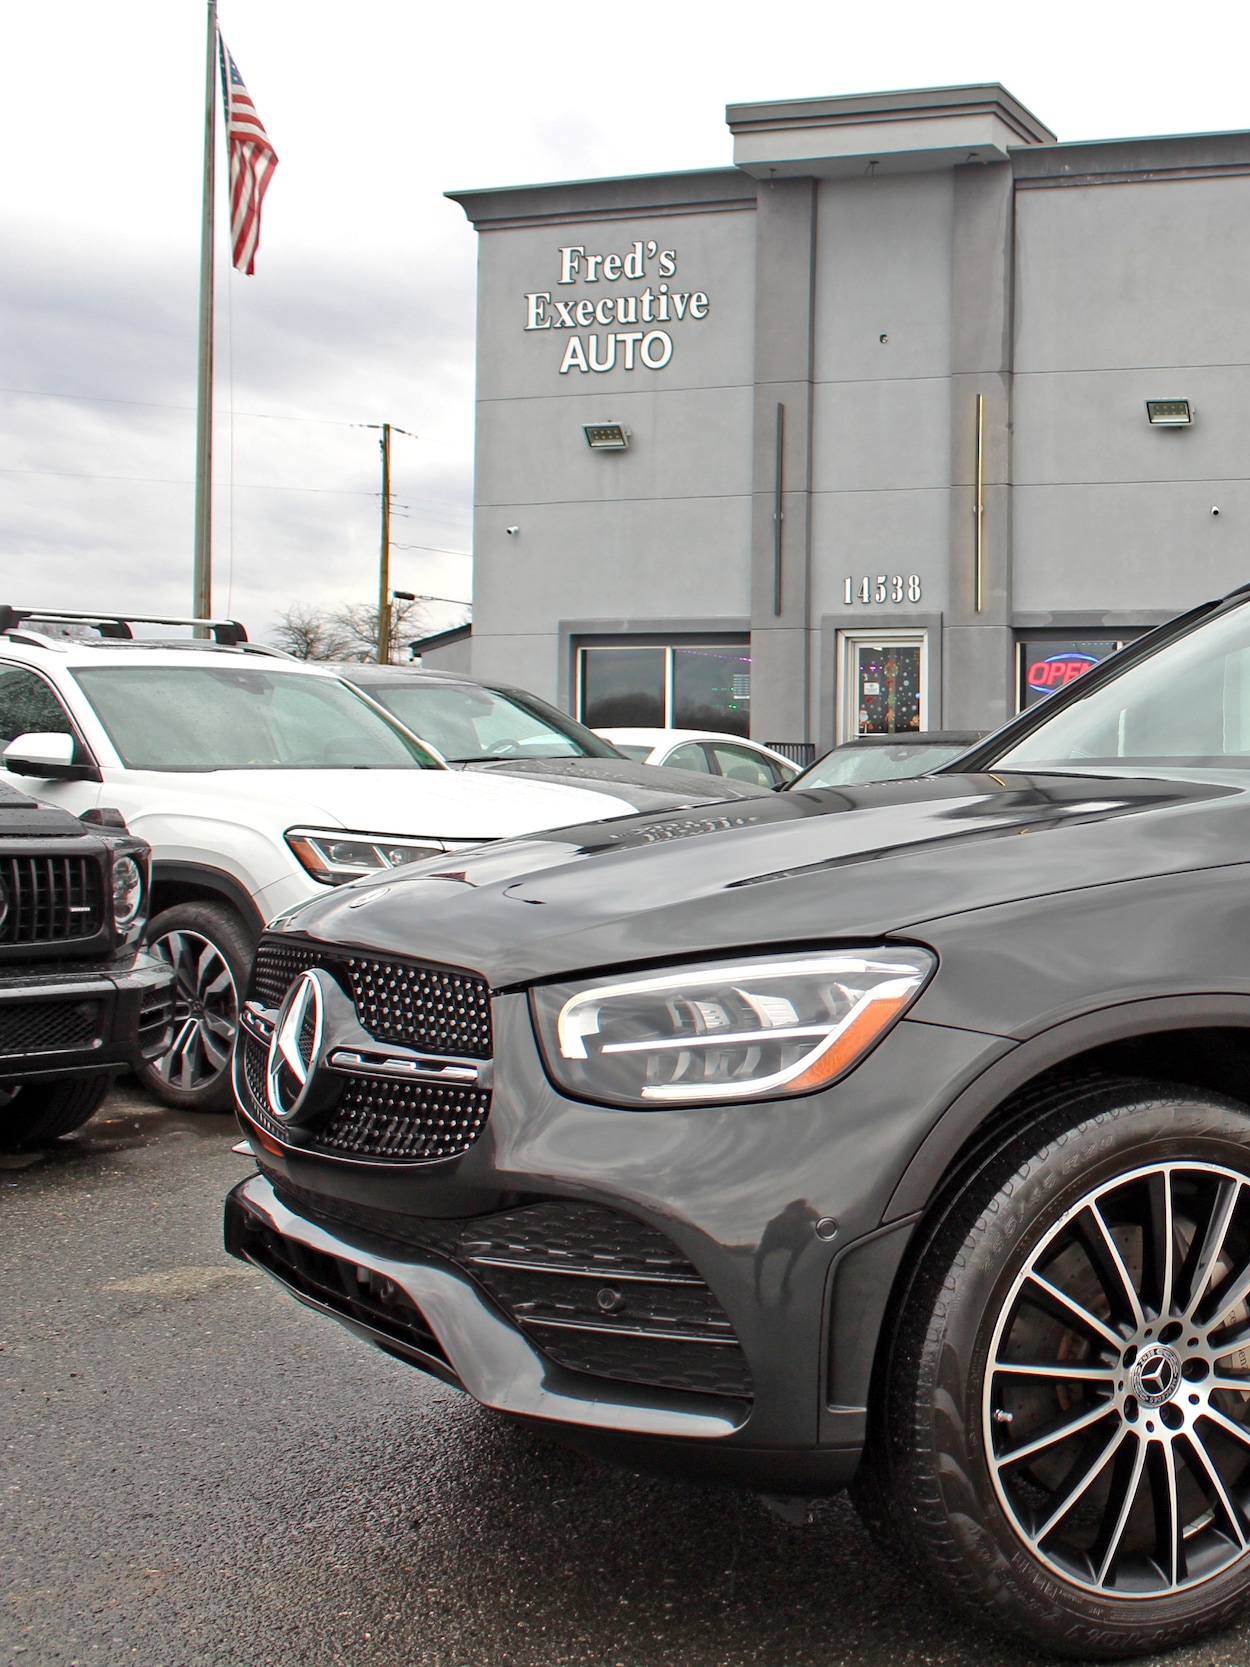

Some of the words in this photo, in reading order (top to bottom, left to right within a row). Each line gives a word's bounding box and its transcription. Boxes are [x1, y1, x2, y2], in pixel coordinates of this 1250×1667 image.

[557, 240, 677, 285] Fred's
[523, 283, 710, 331] Executive
[559, 329, 674, 375] AUTO
[843, 573, 922, 605] 14538
